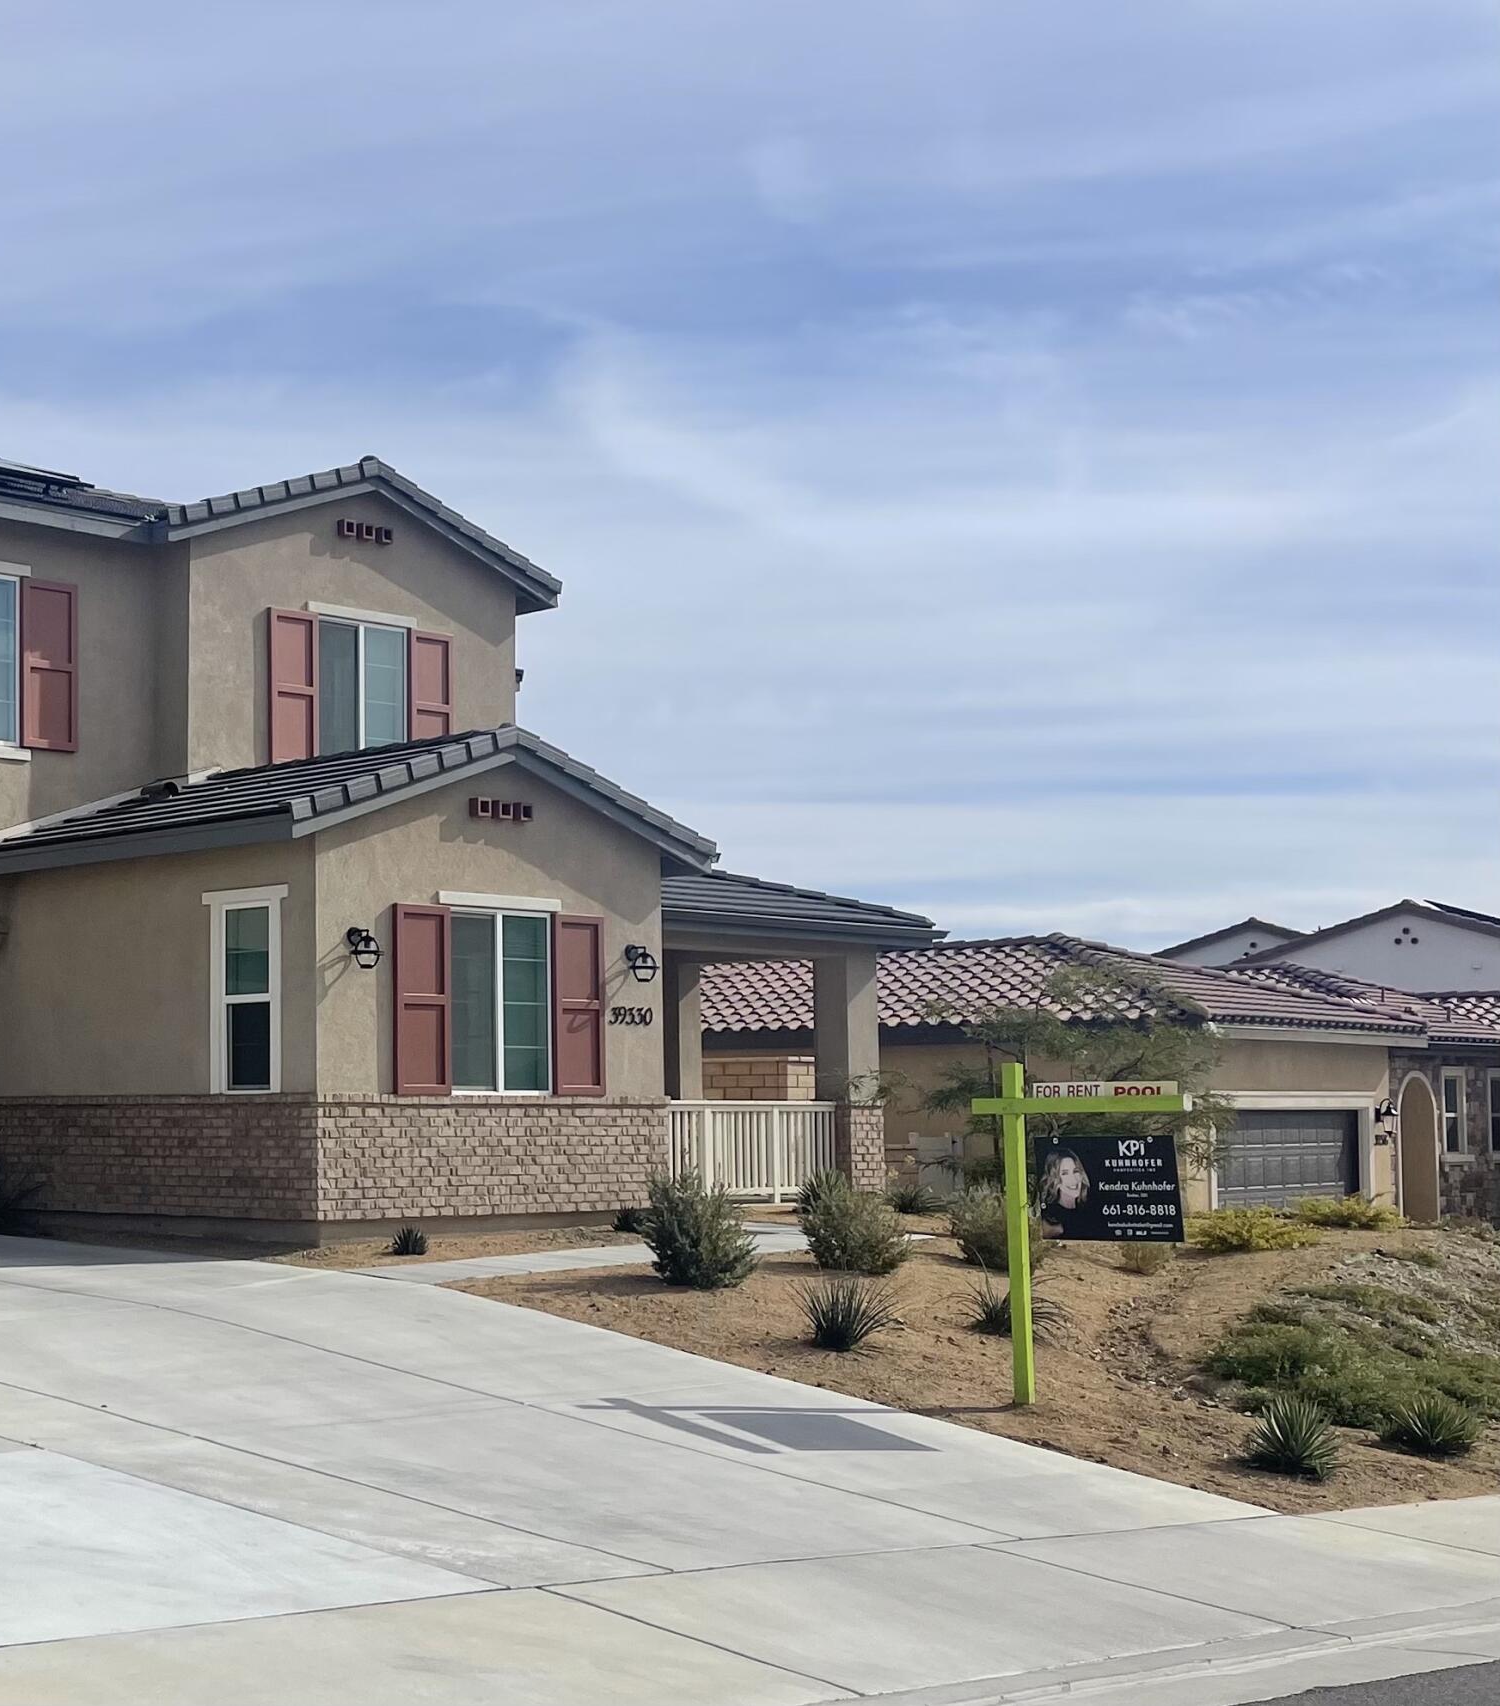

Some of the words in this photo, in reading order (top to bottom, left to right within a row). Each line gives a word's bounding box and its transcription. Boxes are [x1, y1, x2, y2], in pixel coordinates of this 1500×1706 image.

[609, 1006, 653, 1025] 39330
[1035, 1085, 1060, 1098] FOR
[1067, 1085, 1101, 1097] RENT
[1104, 1159, 1162, 1167] KUHNHOFER
[1099, 1181, 1129, 1191] Kendra
[1131, 1181, 1175, 1191] Kuhnhofer
[1102, 1204, 1176, 1216] 661-816-8818
